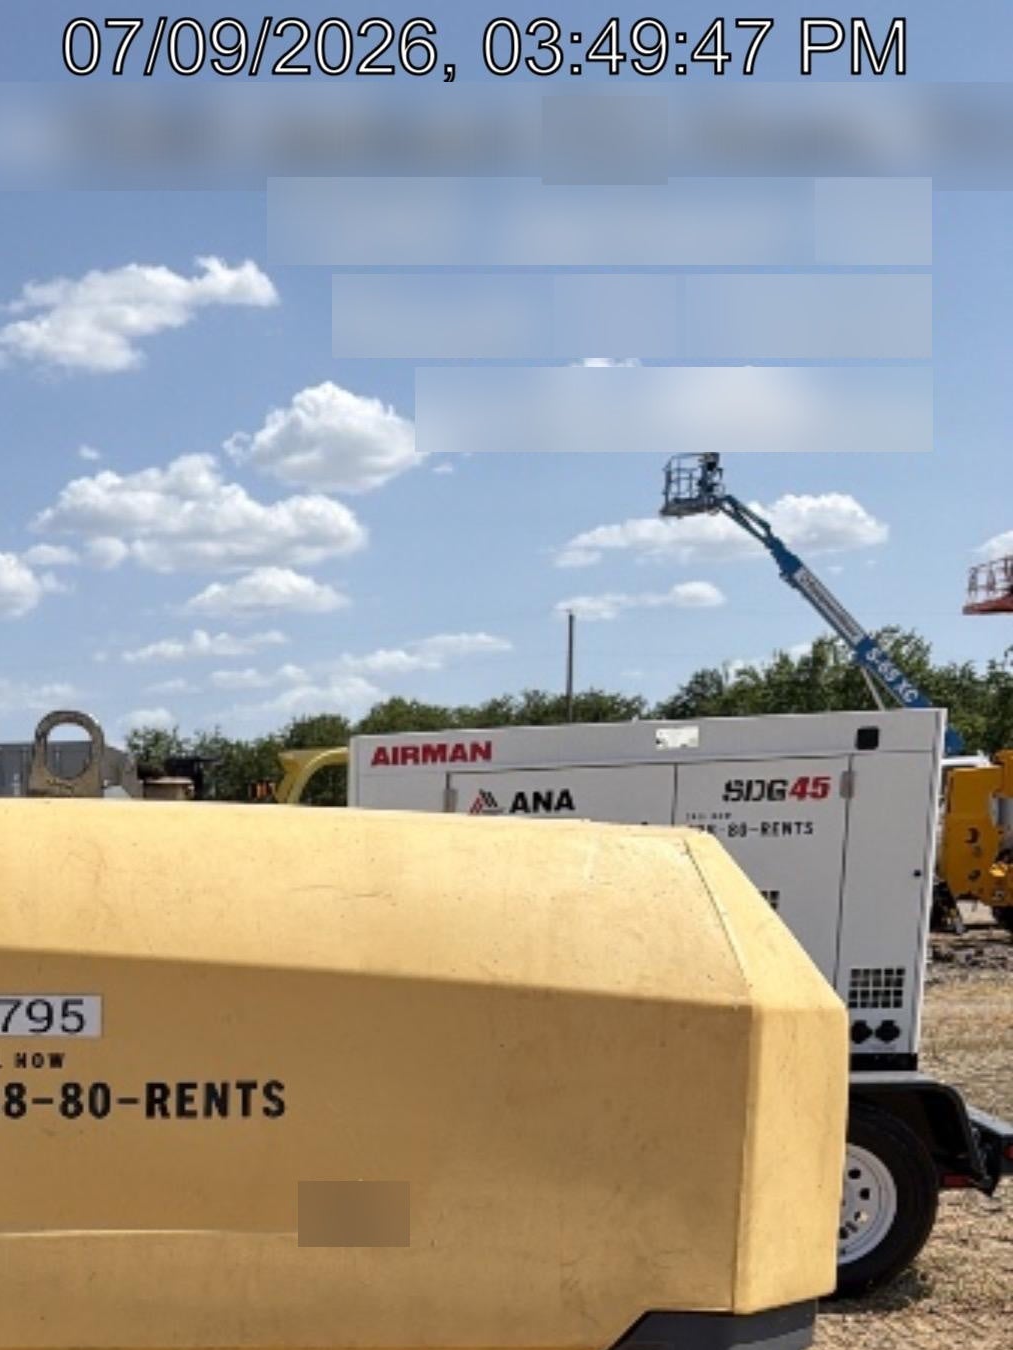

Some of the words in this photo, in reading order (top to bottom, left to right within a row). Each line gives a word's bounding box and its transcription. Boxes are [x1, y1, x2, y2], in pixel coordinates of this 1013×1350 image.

[370, 741, 493, 766] AIRMAN
[509, 788, 576, 814] ANA
[722, 776, 831, 802] SDG45
[14, 1051, 66, 1069] NOW
